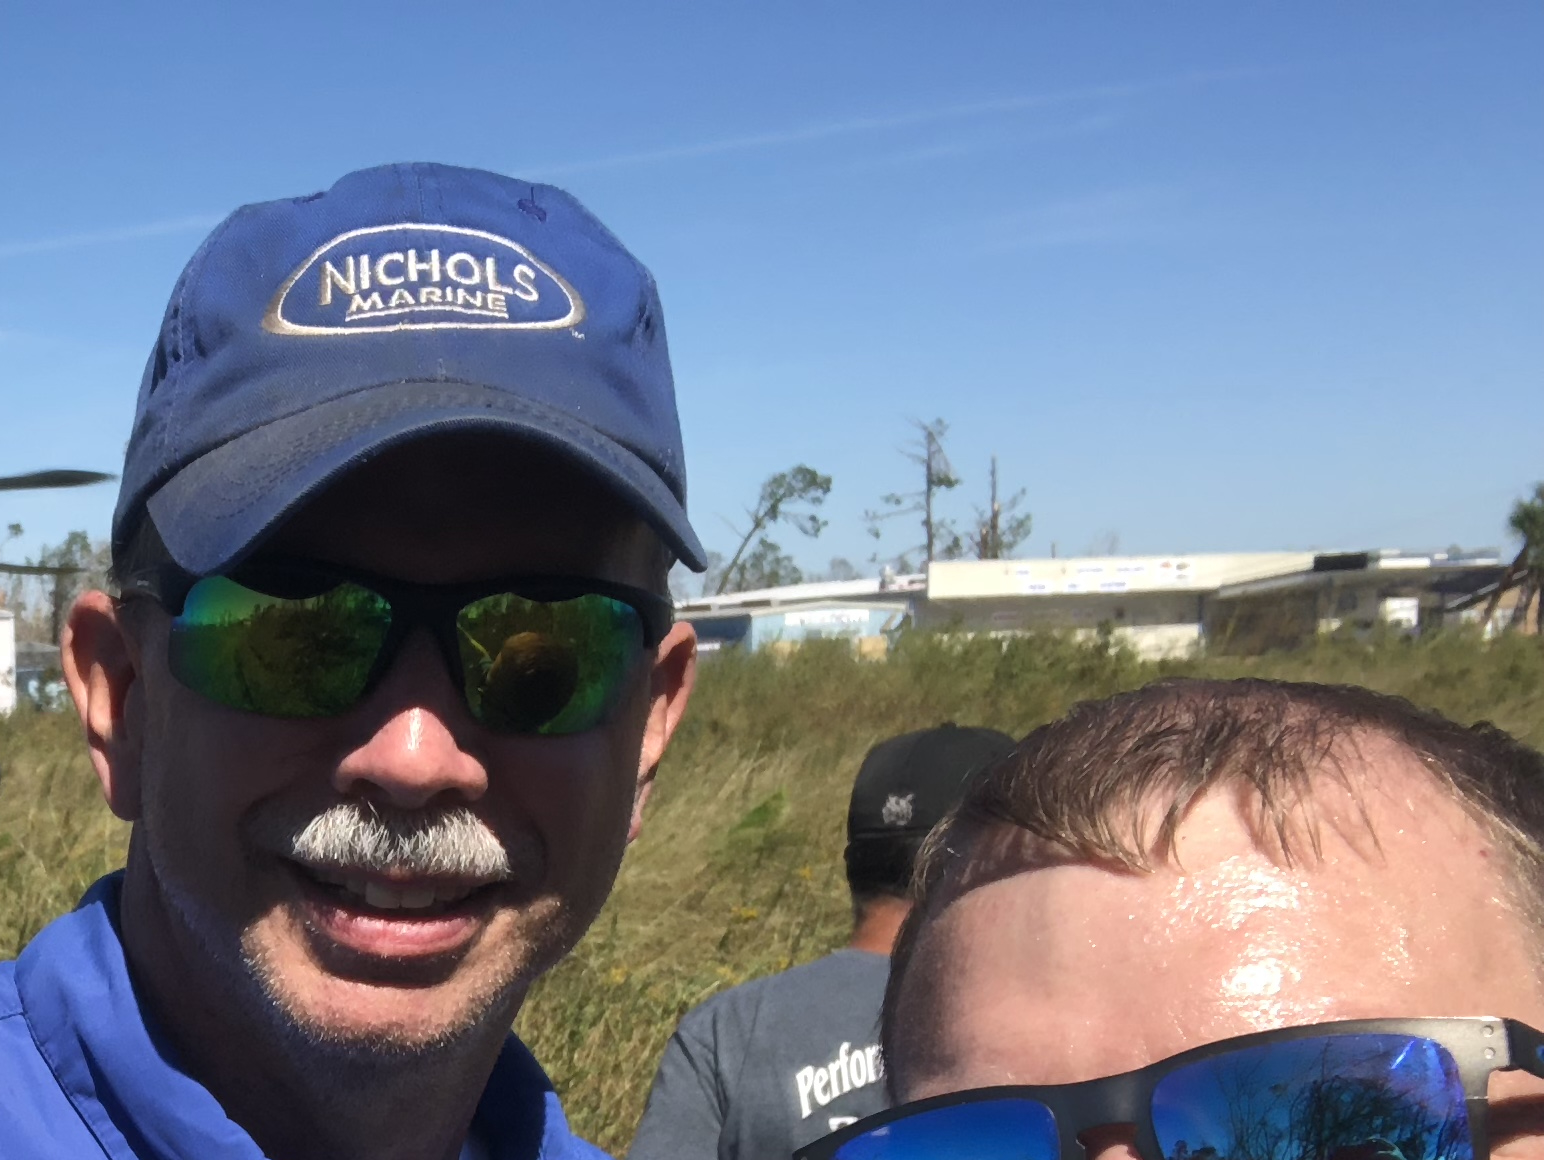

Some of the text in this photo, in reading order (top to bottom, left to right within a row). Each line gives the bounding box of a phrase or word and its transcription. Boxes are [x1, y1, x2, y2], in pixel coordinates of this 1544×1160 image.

[319, 248, 539, 306] NICHOLS
[347, 286, 507, 314] MARINE
[795, 1041, 885, 1119] Perfor
